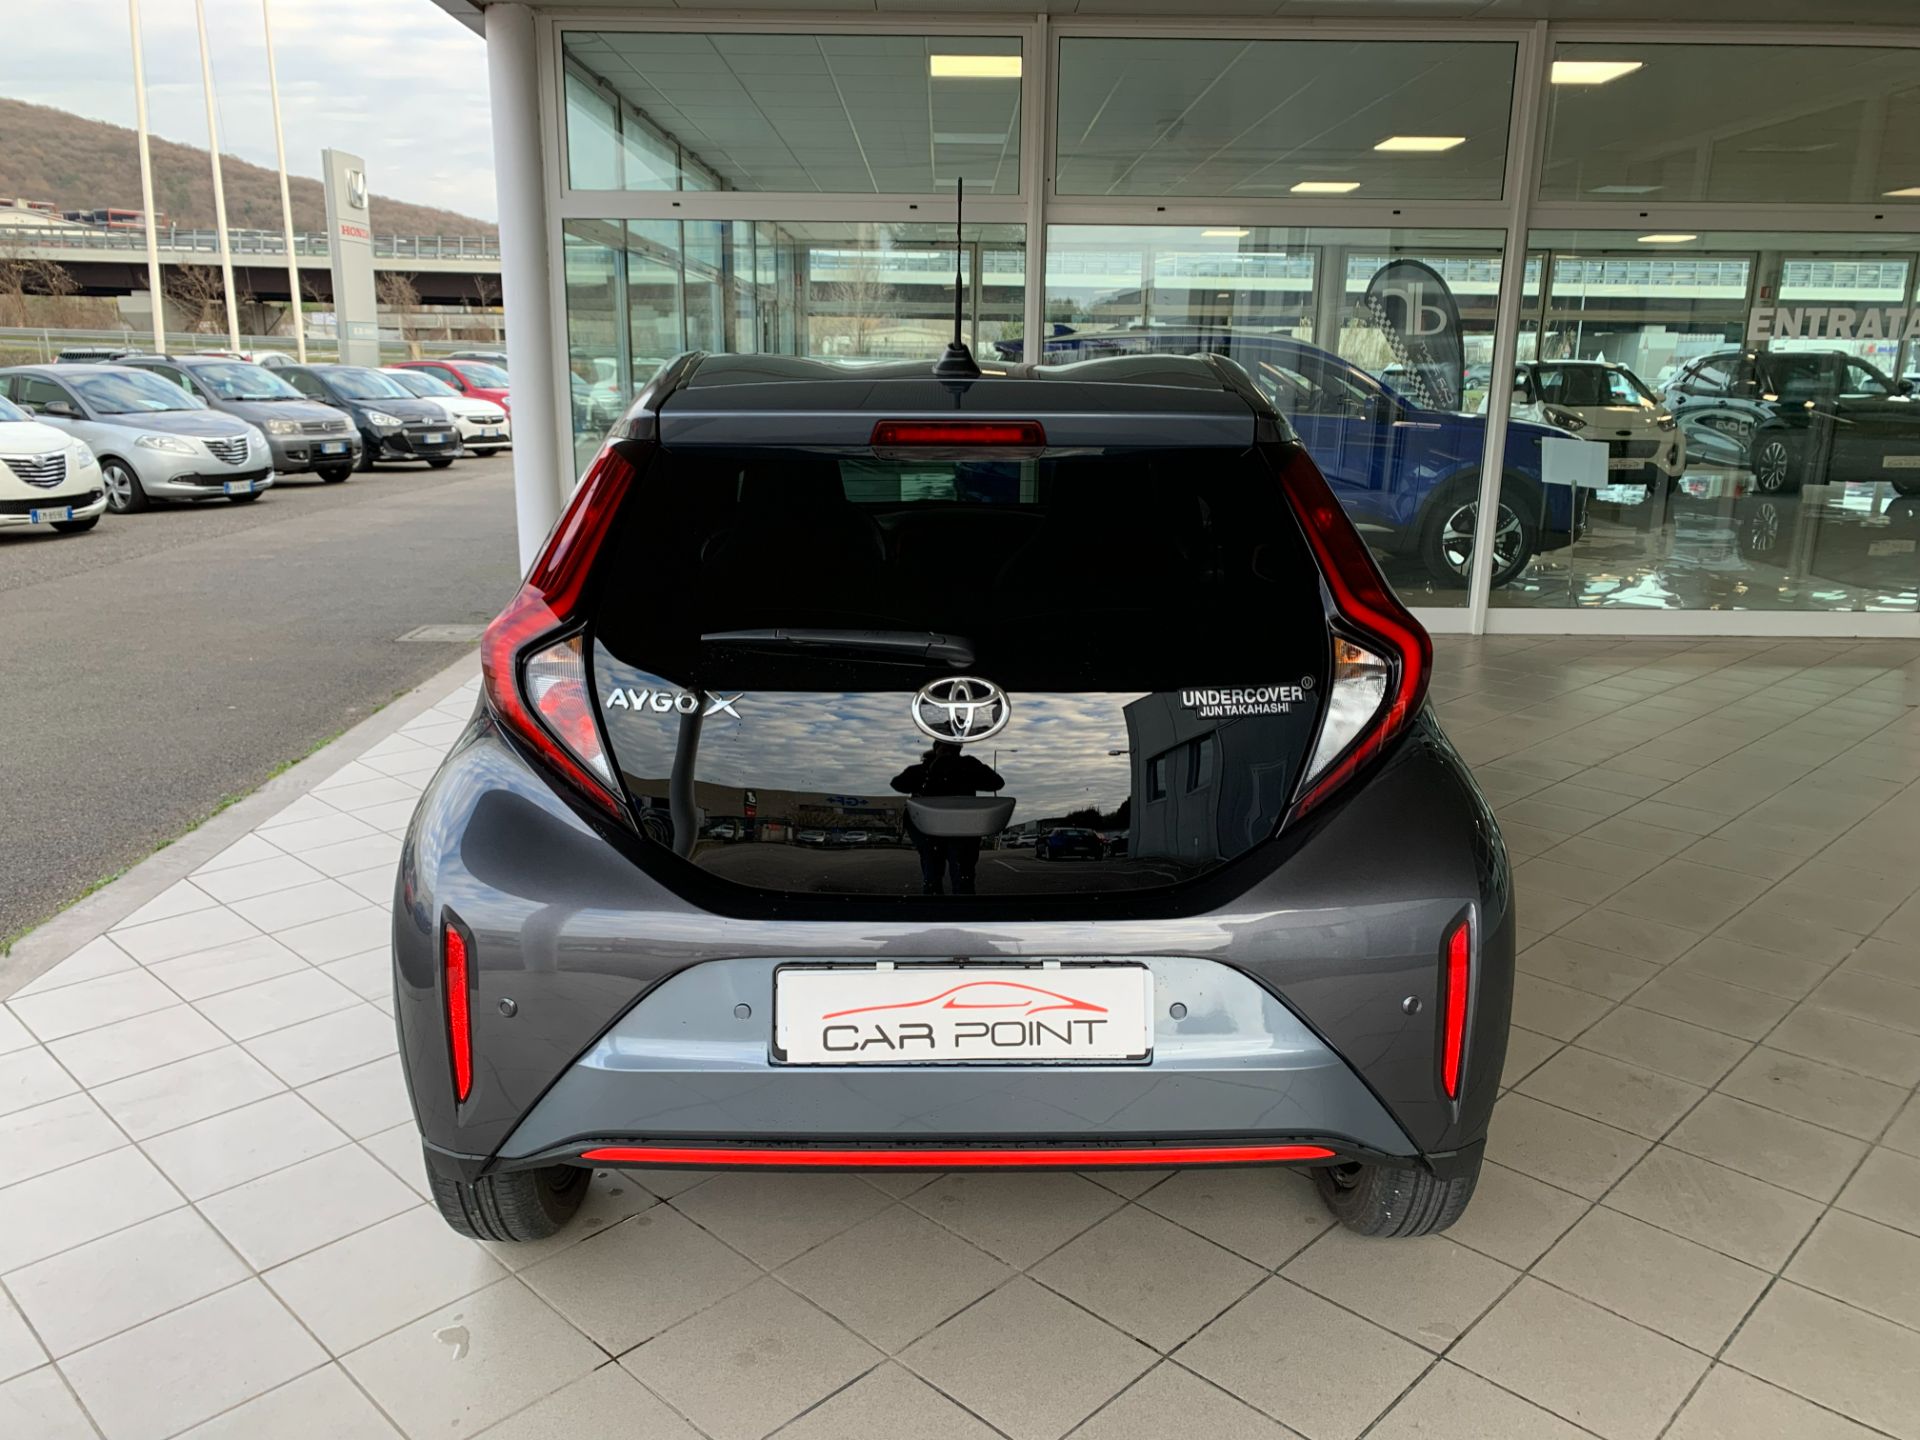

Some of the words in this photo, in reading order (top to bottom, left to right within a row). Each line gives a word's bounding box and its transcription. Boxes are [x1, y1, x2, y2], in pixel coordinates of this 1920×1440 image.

[1747, 307, 1920, 341] ENTRATA
[606, 688, 698, 714] AYGO
[702, 690, 744, 719] X
[1182, 686, 1303, 706] UNDERCOVER
[1200, 705, 1223, 717] JUN
[1224, 702, 1289, 716] TAKAHASHI
[823, 1023, 935, 1052] CAR
[954, 1020, 1108, 1048] POINT
